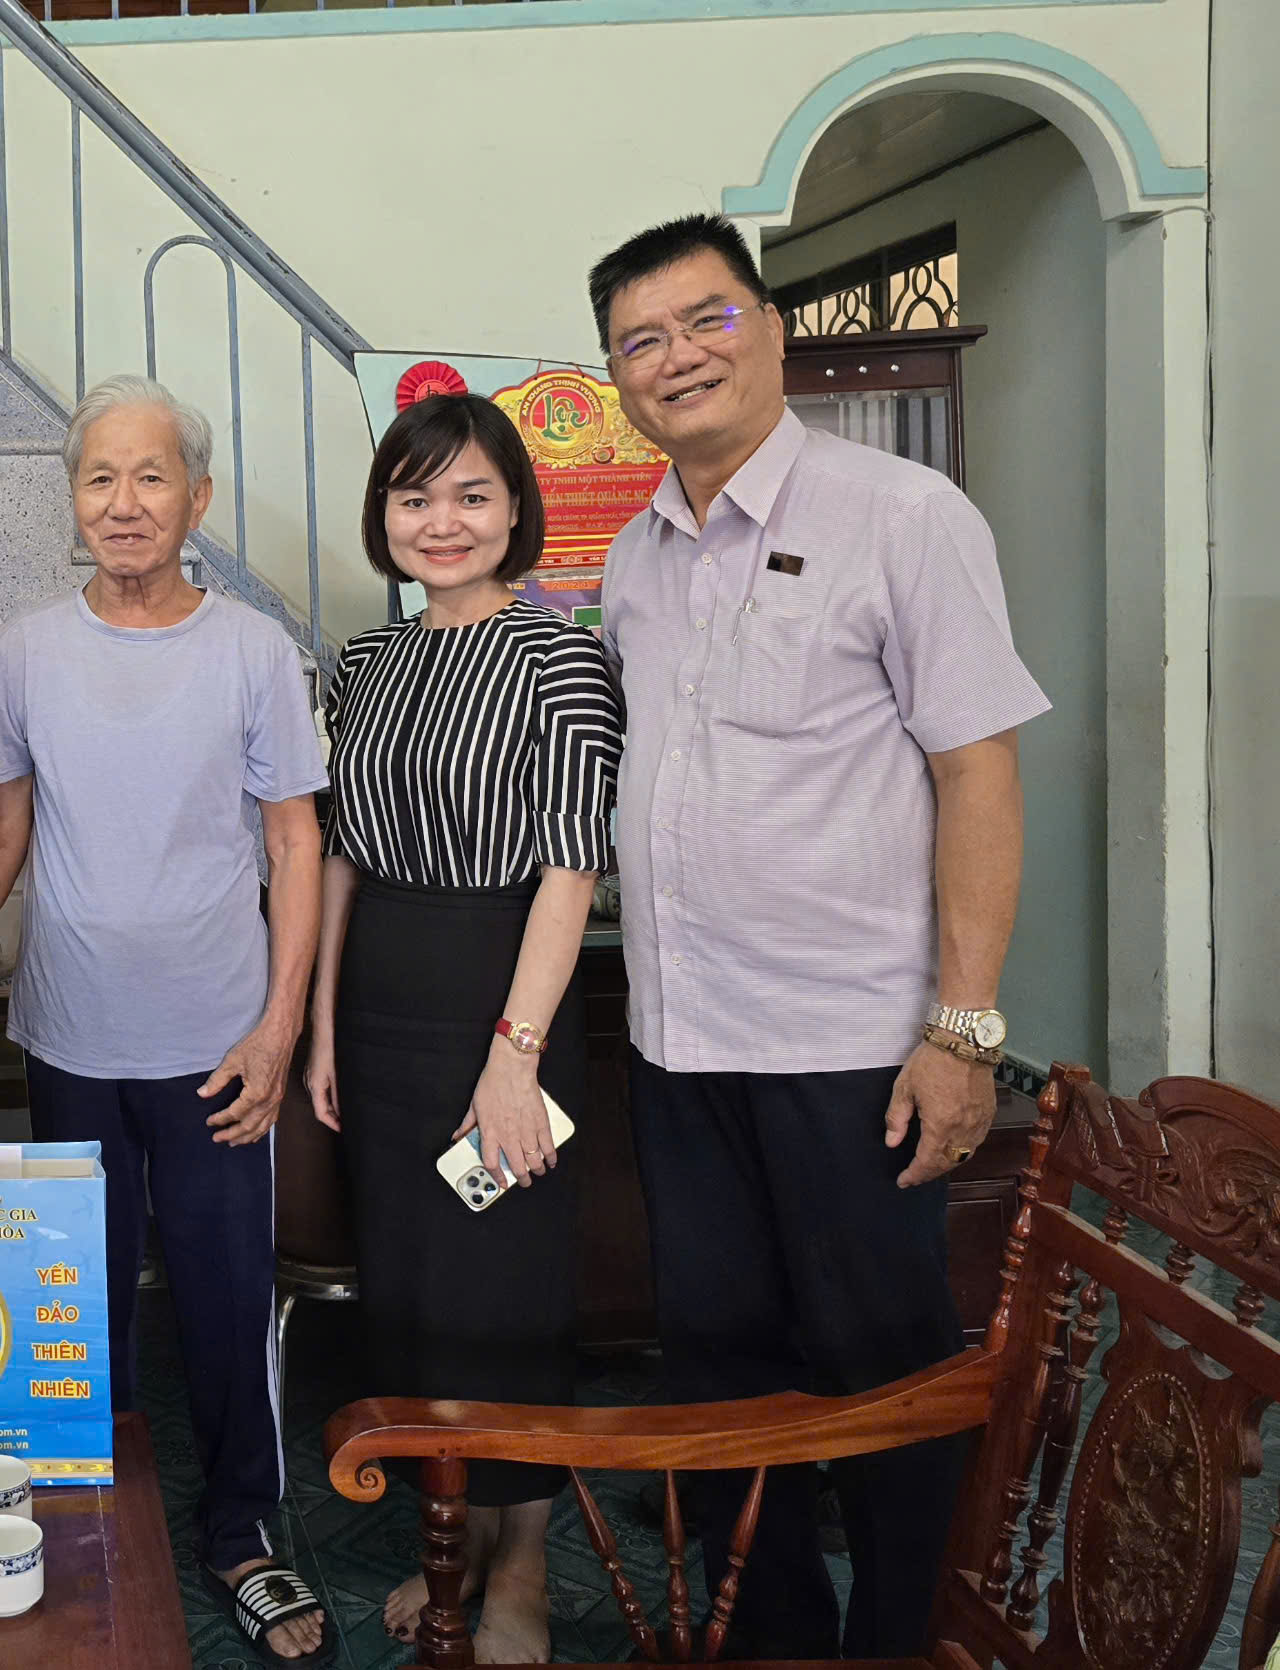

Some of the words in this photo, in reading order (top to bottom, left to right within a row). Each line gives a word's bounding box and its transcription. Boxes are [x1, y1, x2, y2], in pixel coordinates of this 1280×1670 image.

[522, 402, 531, 416] AN
[528, 381, 553, 402] KHANG
[553, 379, 580, 389] THỊNH
[9, 1208, 38, 1222] GIA
[35, 1262, 78, 1285] YẾN
[36, 1300, 79, 1323] ĐẢO
[31, 1340, 86, 1360] THIÊN
[30, 1377, 90, 1399] NHIÊN
